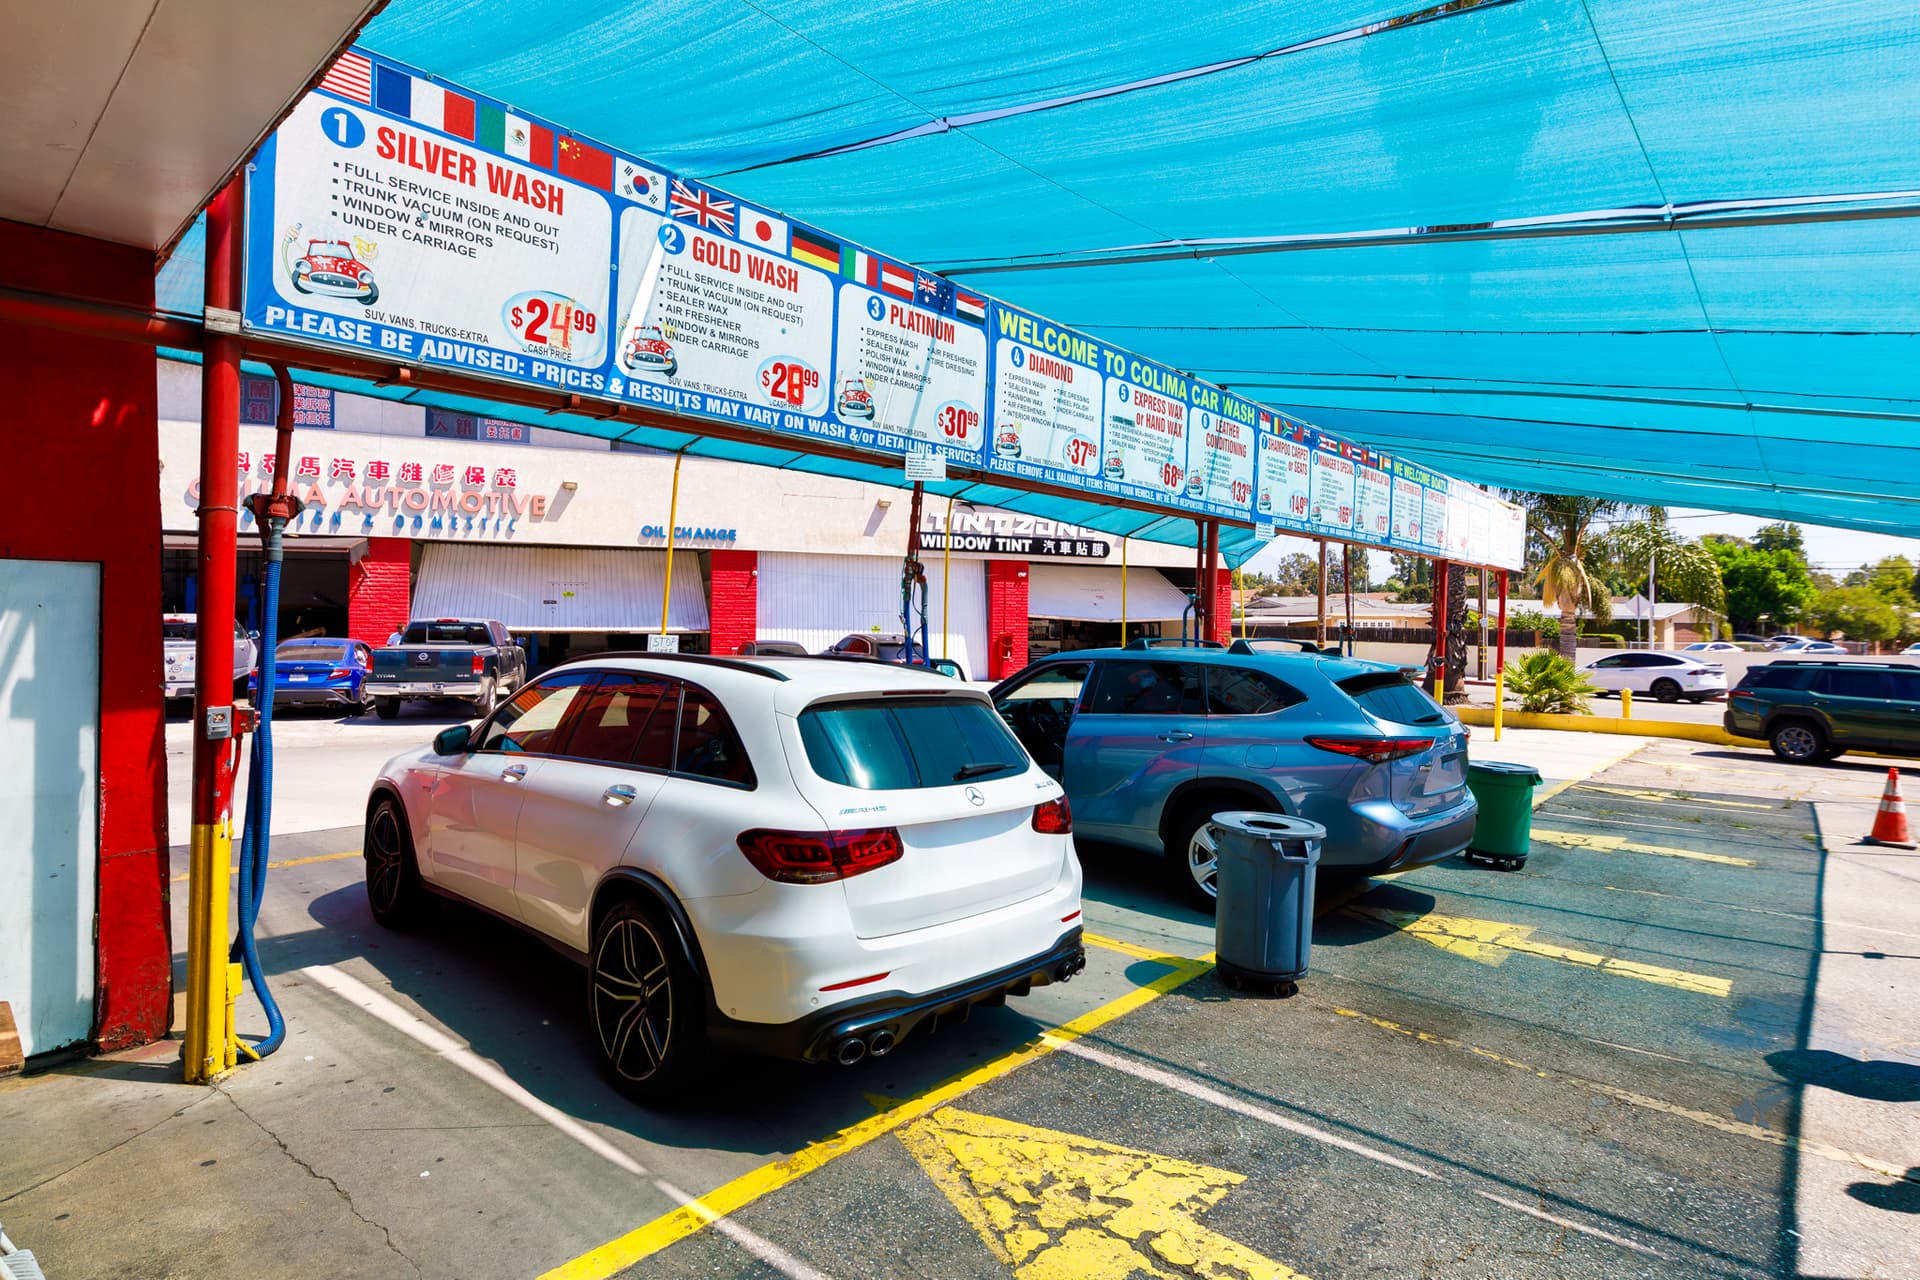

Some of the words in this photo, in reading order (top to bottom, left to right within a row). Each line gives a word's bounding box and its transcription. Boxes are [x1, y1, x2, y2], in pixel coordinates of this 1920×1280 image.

[334, 113, 347, 143] 1
[376, 126, 477, 187] SILVER
[486, 162, 564, 216] WASH
[345, 162, 384, 184] FULL
[388, 176, 452, 205] SERVICE
[456, 197, 500, 220] INSIDE
[503, 213, 531, 229] AND
[534, 222, 560, 238] OUT
[343, 195, 411, 224] WINDOW
[415, 217, 425, 228] &
[429, 221, 494, 248] MIRRORS
[344, 179, 398, 205] TRUNK
[402, 196, 463, 223] VACUUM
[467, 216, 492, 232] (ON
[496, 225, 560, 255] REQUEST)
[343, 212, 397, 238] UNDER
[402, 229, 477, 259] CARRIAGE
[664, 225, 677, 251] 2
[693, 236, 742, 274] GOLD
[747, 254, 799, 293] WASH
[667, 278, 701, 296] TRUNK
[703, 289, 742, 308] VACUUM
[744, 301, 760, 314] (ON
[762, 306, 804, 327] REQUEST)
[668, 265, 692, 280] FULL
[695, 273, 735, 293] SERVICE
[737, 286, 765, 303] INSIDE
[767, 296, 785, 309] AND
[787, 302, 804, 314] OUT
[666, 291, 705, 309] SEALER
[708, 303, 729, 316] WAX
[871, 298, 880, 318] 3
[365, 309, 387, 324] SUV,
[389, 314, 417, 331] VANS,
[420, 321, 489, 344] TRUCKS-EXTRA
[666, 304, 683, 316] AIR
[685, 309, 742, 332] FRESHENER
[890, 304, 955, 345] PLATINUM
[665, 316, 708, 335] WINDOW
[710, 329, 717, 338] &
[719, 332, 760, 350] MIRRORS
[665, 330, 699, 347] UNDER
[702, 339, 749, 359] CARRIAGE
[866, 328, 898, 344] EXPRESS
[900, 337, 919, 350] WASH
[550, 350, 572, 362] PRICE
[866, 339, 894, 353] SEALER
[895, 346, 910, 358] WAX
[866, 349, 891, 363] POLISH
[892, 356, 908, 368] WAX
[931, 348, 942, 357] AIR
[943, 352, 978, 368] FRESHENER
[865, 359, 895, 375] WINDOW
[902, 370, 932, 385] MIRRORS
[931, 358, 945, 369] TIRE
[946, 361, 975, 377] DRESSING
[999, 308, 1099, 369] WELCOME
[1104, 350, 1126, 378] TO
[1131, 358, 1188, 402] COLIMA
[1191, 380, 1220, 414] CAR
[1223, 392, 1256, 426] WASH
[1029, 353, 1074, 385] DIAMOND
[265, 305, 372, 345] PLEASE
[381, 328, 413, 354] BE
[419, 339, 525, 375] ADVISED:
[532, 361, 605, 391] PRICES
[609, 378, 625, 395] &
[629, 381, 702, 410] RESULTS
[706, 397, 741, 418] MAY
[744, 403, 781, 427] VARY
[784, 414, 804, 430] ON
[808, 421, 846, 439] WASH
[878, 433, 934, 456] DETAILING
[936, 445, 983, 465] SERVICES
[703, 384, 748, 401] TRUCKS-EXTRA
[865, 371, 889, 384] UNDER
[890, 378, 924, 393] CARRIAGE
[1134, 390, 1167, 415] EXPRESS
[1168, 401, 1184, 421] WAX
[1136, 412, 1145, 426] or
[1146, 413, 1166, 433] HAND
[1168, 420, 1183, 438] WAX
[1216, 418, 1240, 439] LEATHER
[1206, 433, 1247, 458] CONDITIONING
[990, 458, 1017, 473] PLEASE
[1017, 463, 1044, 479] REMOVE
[1045, 469, 1056, 480] ALL
[1057, 471, 1086, 486] VALUABLE
[1086, 478, 1103, 489] ITEMS
[1104, 482, 1120, 493] FROM
[1295, 461, 1308, 476] SEATS
[1394, 461, 1404, 475] WE
[1404, 466, 1431, 487] WELCOME
[339, 484, 547, 517] AUTOMOTIVE
[395, 515, 516, 533] DOMESTIC
[641, 525, 667, 539] OIL
[674, 527, 737, 542] CHANGE
[920, 534, 992, 551] WINDOW
[996, 539, 1033, 553] TINT
[1043, 540, 1105, 557] 汽車貼膜
